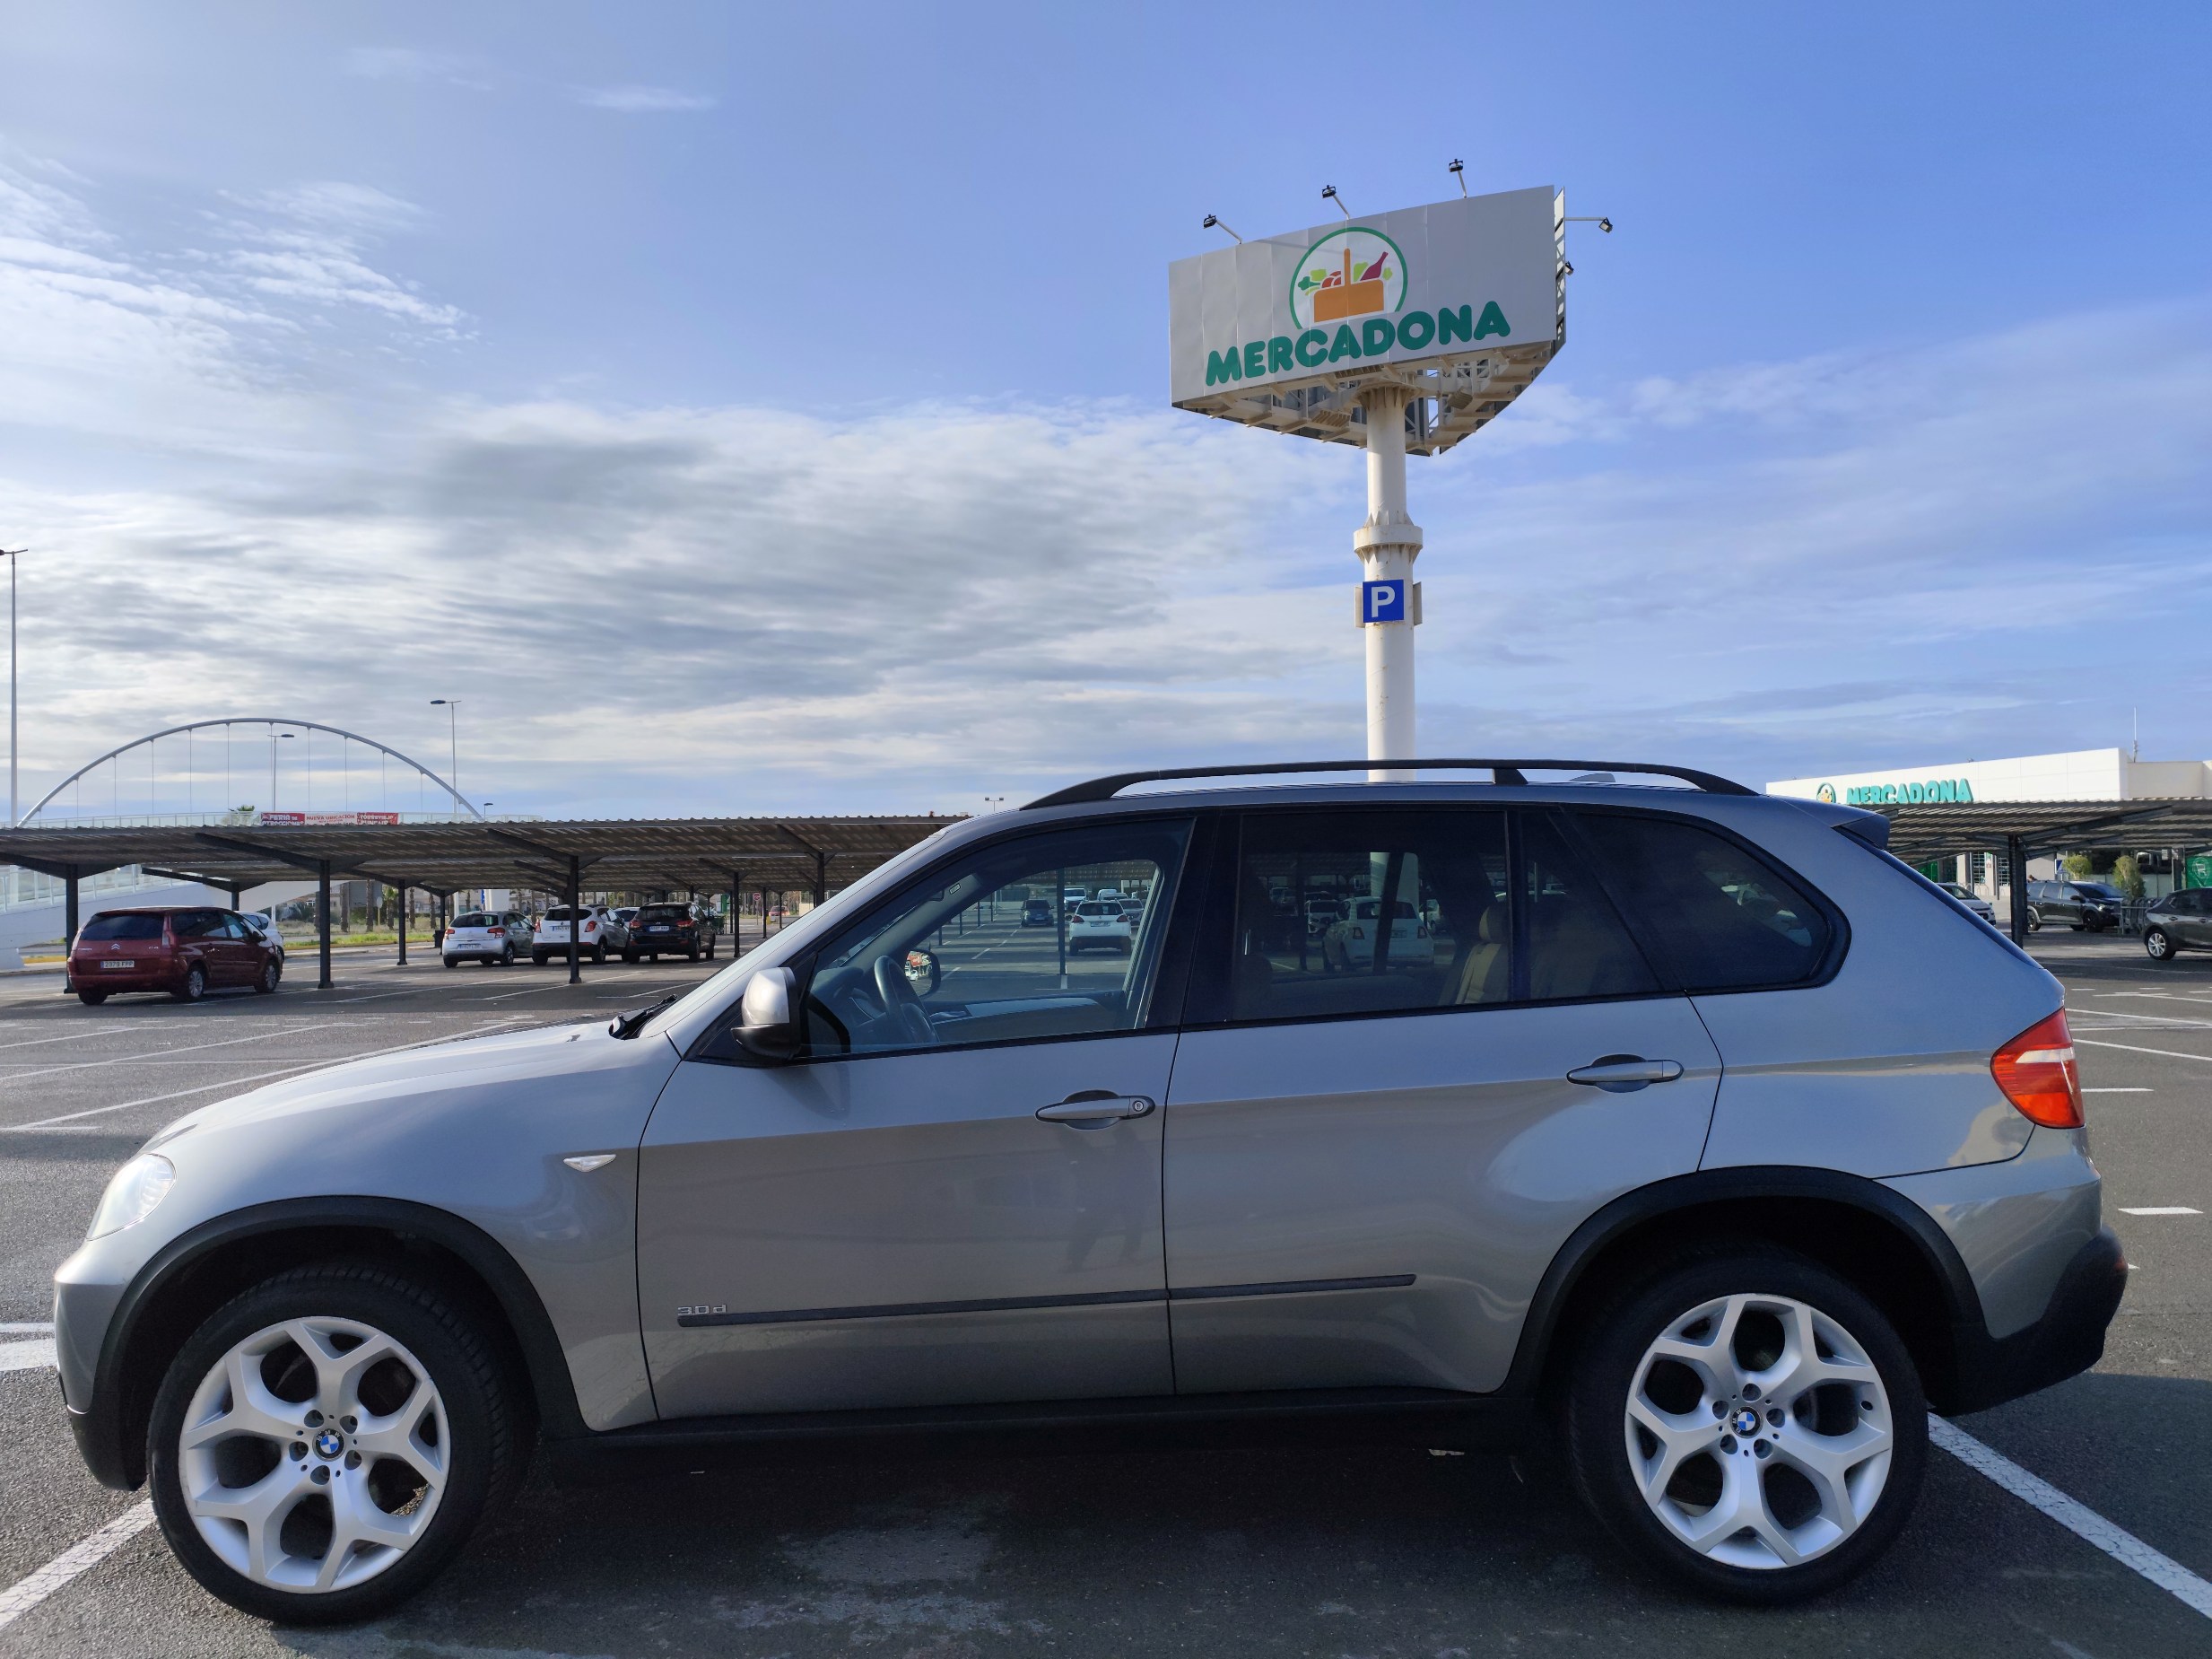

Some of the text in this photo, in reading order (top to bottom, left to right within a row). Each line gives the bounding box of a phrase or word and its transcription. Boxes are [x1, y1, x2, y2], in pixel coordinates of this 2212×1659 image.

[1205, 301, 1511, 387] MERCADONA
[1370, 585, 1396, 618] P
[1846, 778, 1973, 805] MERCADONA
[316, 1429, 341, 1442] BMW
